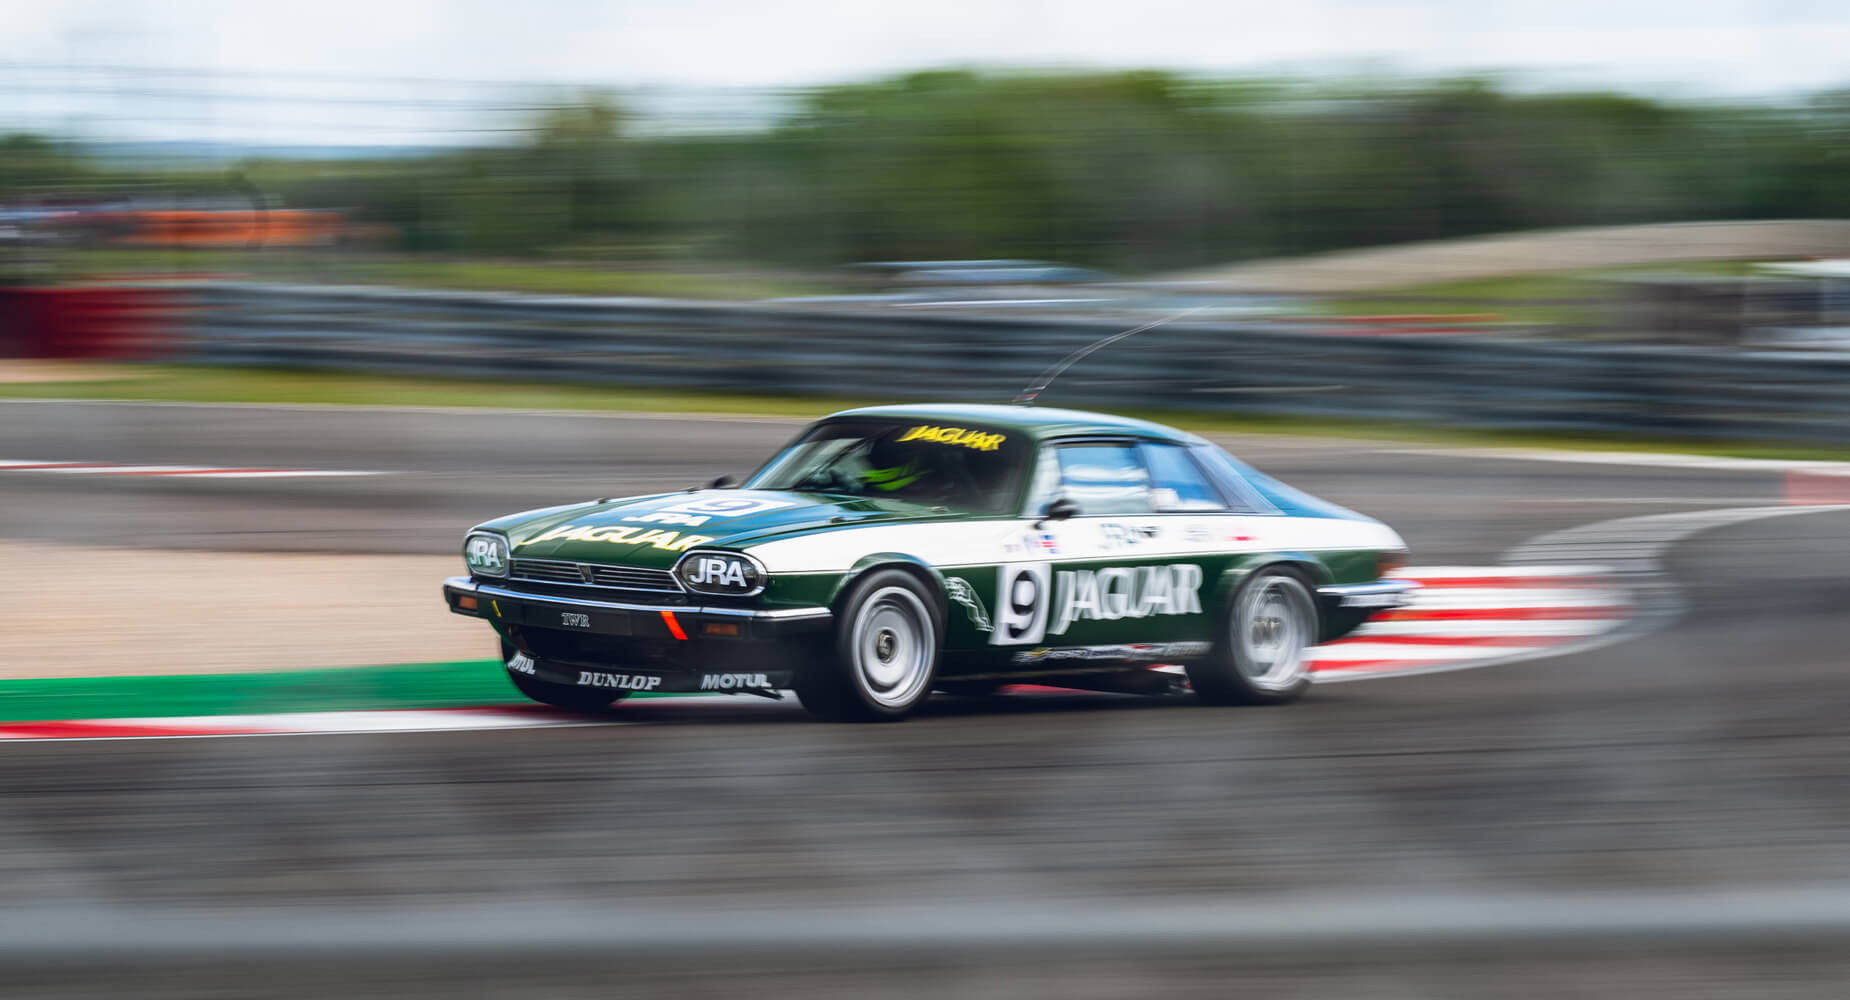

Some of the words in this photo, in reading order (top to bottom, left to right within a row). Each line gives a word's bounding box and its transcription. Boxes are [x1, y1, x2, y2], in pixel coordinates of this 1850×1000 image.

[897, 425, 1006, 451] JAGUAR
[519, 525, 715, 551] JAGUAR
[470, 539, 501, 567] JRA
[689, 558, 747, 587] JRA
[1008, 569, 1039, 640] 9
[1048, 563, 1202, 635] JAGUAR
[561, 613, 590, 628] TWR
[577, 671, 661, 690] DUNLOP
[701, 673, 772, 690] MOTUL
